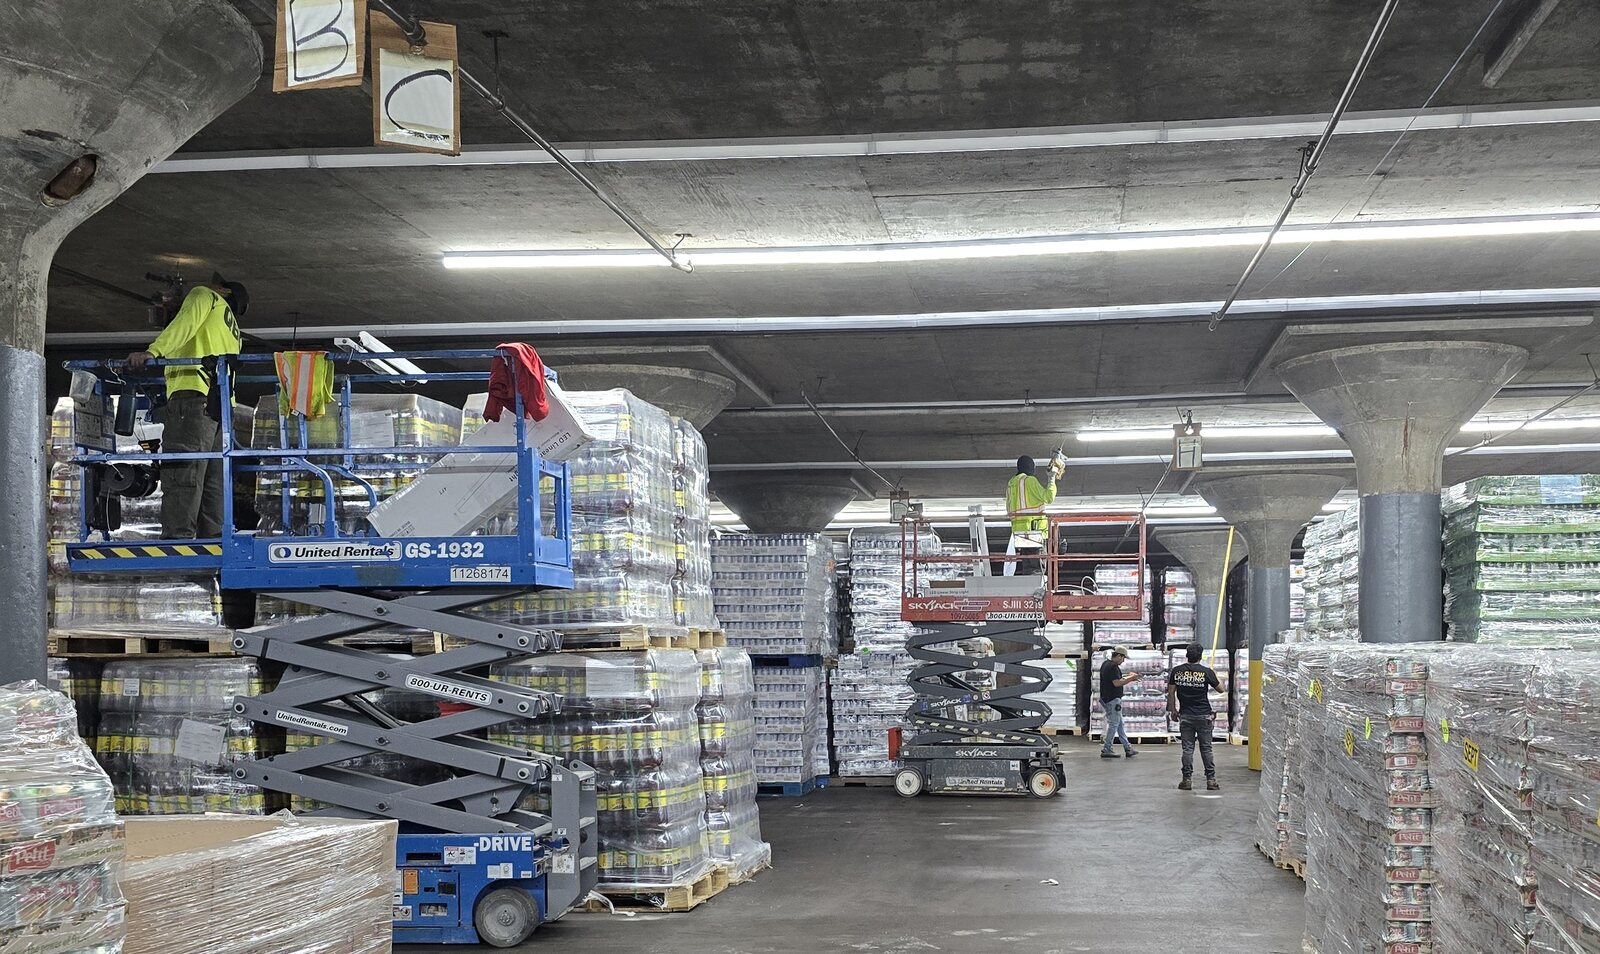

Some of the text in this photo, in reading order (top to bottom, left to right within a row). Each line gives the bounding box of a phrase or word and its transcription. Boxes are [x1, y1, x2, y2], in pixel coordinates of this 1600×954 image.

[289, 0, 349, 82] B
[558, 432, 571, 444] LED
[539, 441, 559, 458] Linear
[295, 544, 394, 559] United Rentals
[405, 542, 484, 558] GS-1932
[452, 568, 509, 579] 11268174
[908, 600, 960, 611] SKYJACK
[410, 677, 488, 702] 800-UR-RENTS
[277, 712, 347, 734] UnitedRentals.com
[955, 748, 997, 758] SKYJACK
[1464, 741, 1478, 768] SEPT
[15, 846, 50, 865] Petit
